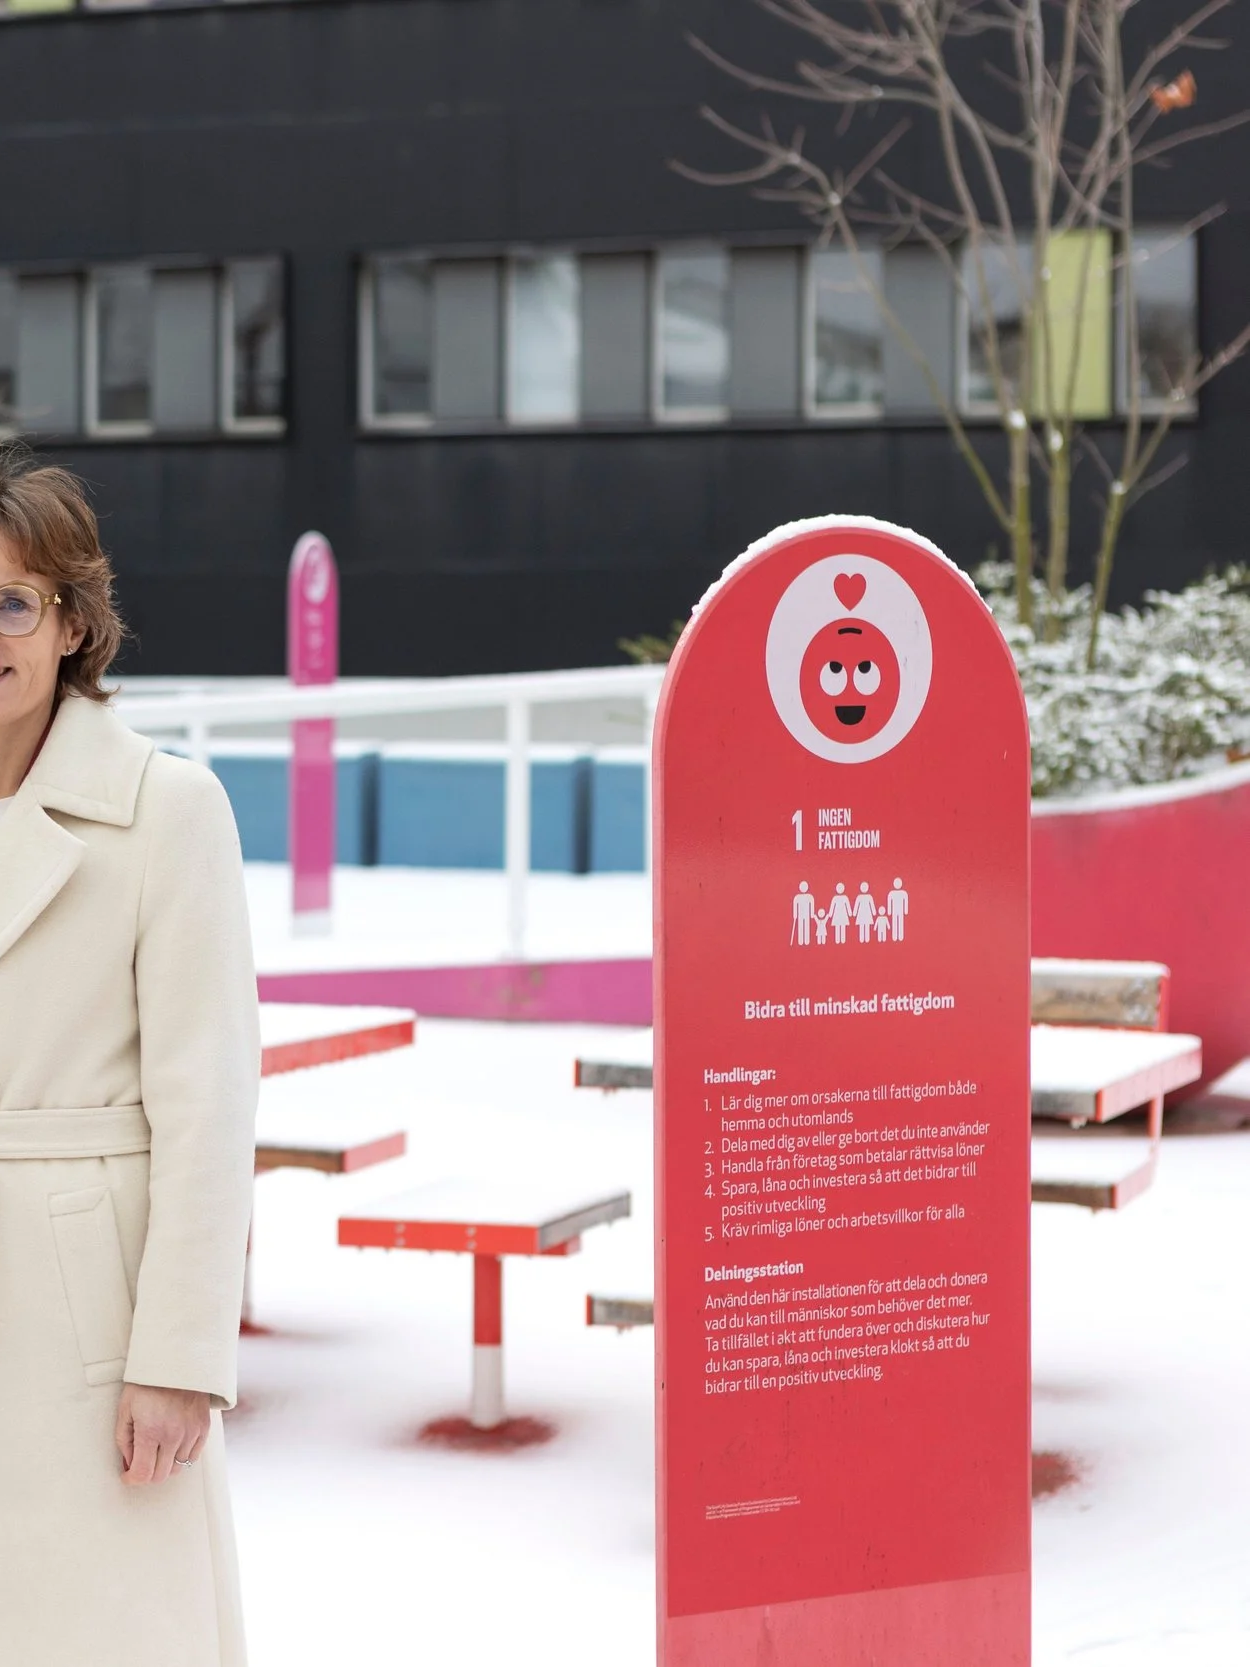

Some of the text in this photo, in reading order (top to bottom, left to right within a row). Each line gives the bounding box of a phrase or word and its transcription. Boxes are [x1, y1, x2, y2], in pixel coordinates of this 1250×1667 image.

[792, 810, 802, 850] 1
[819, 808, 851, 827] INGEN
[819, 830, 880, 849] FATTIGDOM
[745, 992, 954, 1019] Bidra till minskad fattigdom
[704, 1067, 776, 1085] Handlingar:
[704, 1080, 976, 1112] 1. Lär dig mer om orsakerna till fattigdom både
[722, 1109, 853, 1131] hemma och utomlands
[705, 1120, 990, 1154] 2. Dela med dig av eller ge bort det du inte använder
[705, 1142, 985, 1178] 3. Handla från företag som betalar rättvisa löner
[705, 1161, 976, 1199] 4. Spara, låna och investera så att det bidrar till
[705, 1204, 964, 1242] 5. Kräv rimliga löner och arbetsvillkor för alla
[722, 1195, 826, 1221] positiv utveckling
[705, 1260, 803, 1283] Delningsstation
[705, 1272, 987, 1309] Använd den här installationen för att dela och donera
[705, 1295, 972, 1330] vad du kan till människor som behöver det mer.
[705, 1337, 719, 1352] Ta
[722, 1333, 769, 1350] tillfället
[777, 1330, 796, 1344] akt
[799, 1329, 815, 1342] att
[818, 1324, 863, 1340] fundera
[866, 1322, 890, 1336] över
[894, 1318, 913, 1333] och
[916, 1315, 969, 1331] diskutera
[972, 1311, 990, 1325] hur
[705, 1333, 969, 1373] du kan spara, låna och investera klokt så att du
[706, 1364, 883, 1394] bidrar till en positiv utveckling.
